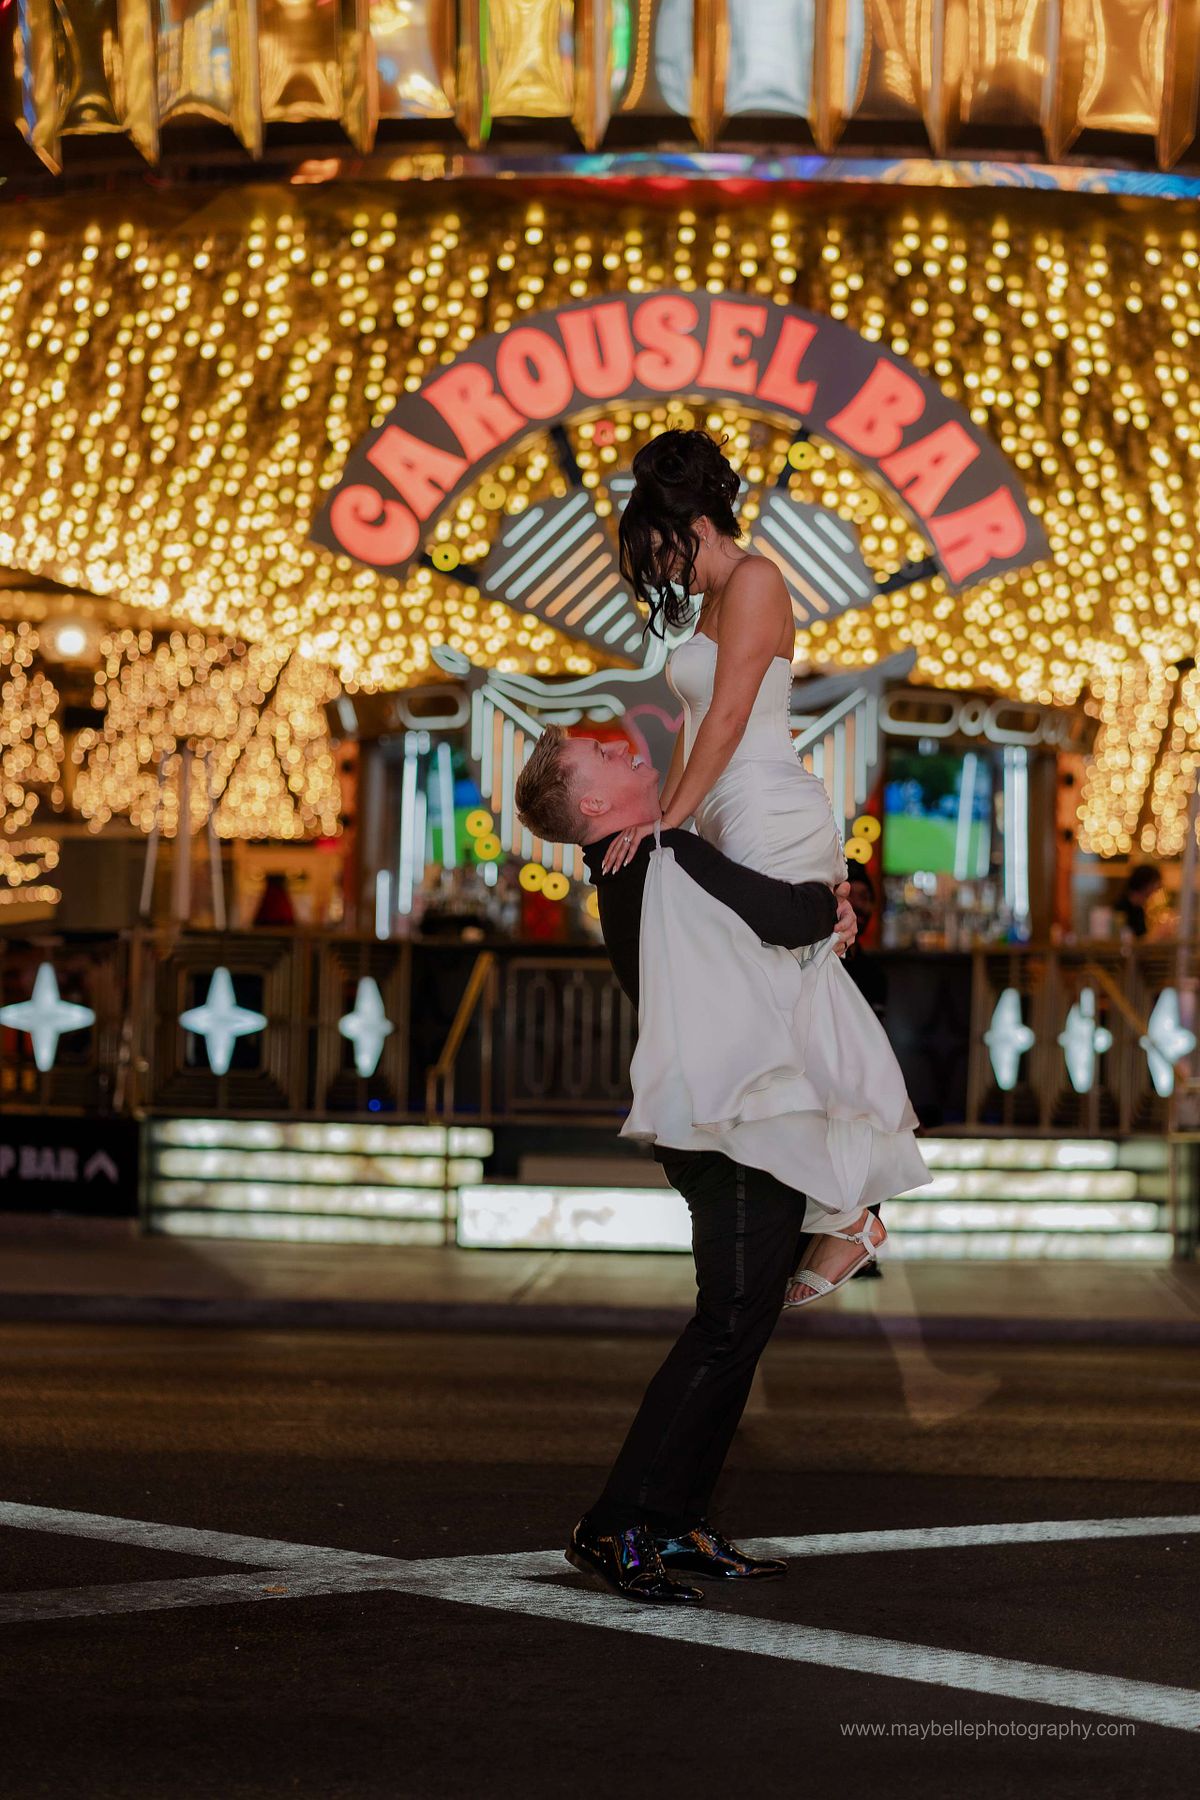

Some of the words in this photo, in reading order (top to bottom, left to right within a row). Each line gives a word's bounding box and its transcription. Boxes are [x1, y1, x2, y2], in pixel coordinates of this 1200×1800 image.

[330, 295, 818, 567] CAROUSEL
[828, 359, 1027, 584] BAR
[19, 1147, 78, 1181] BAR
